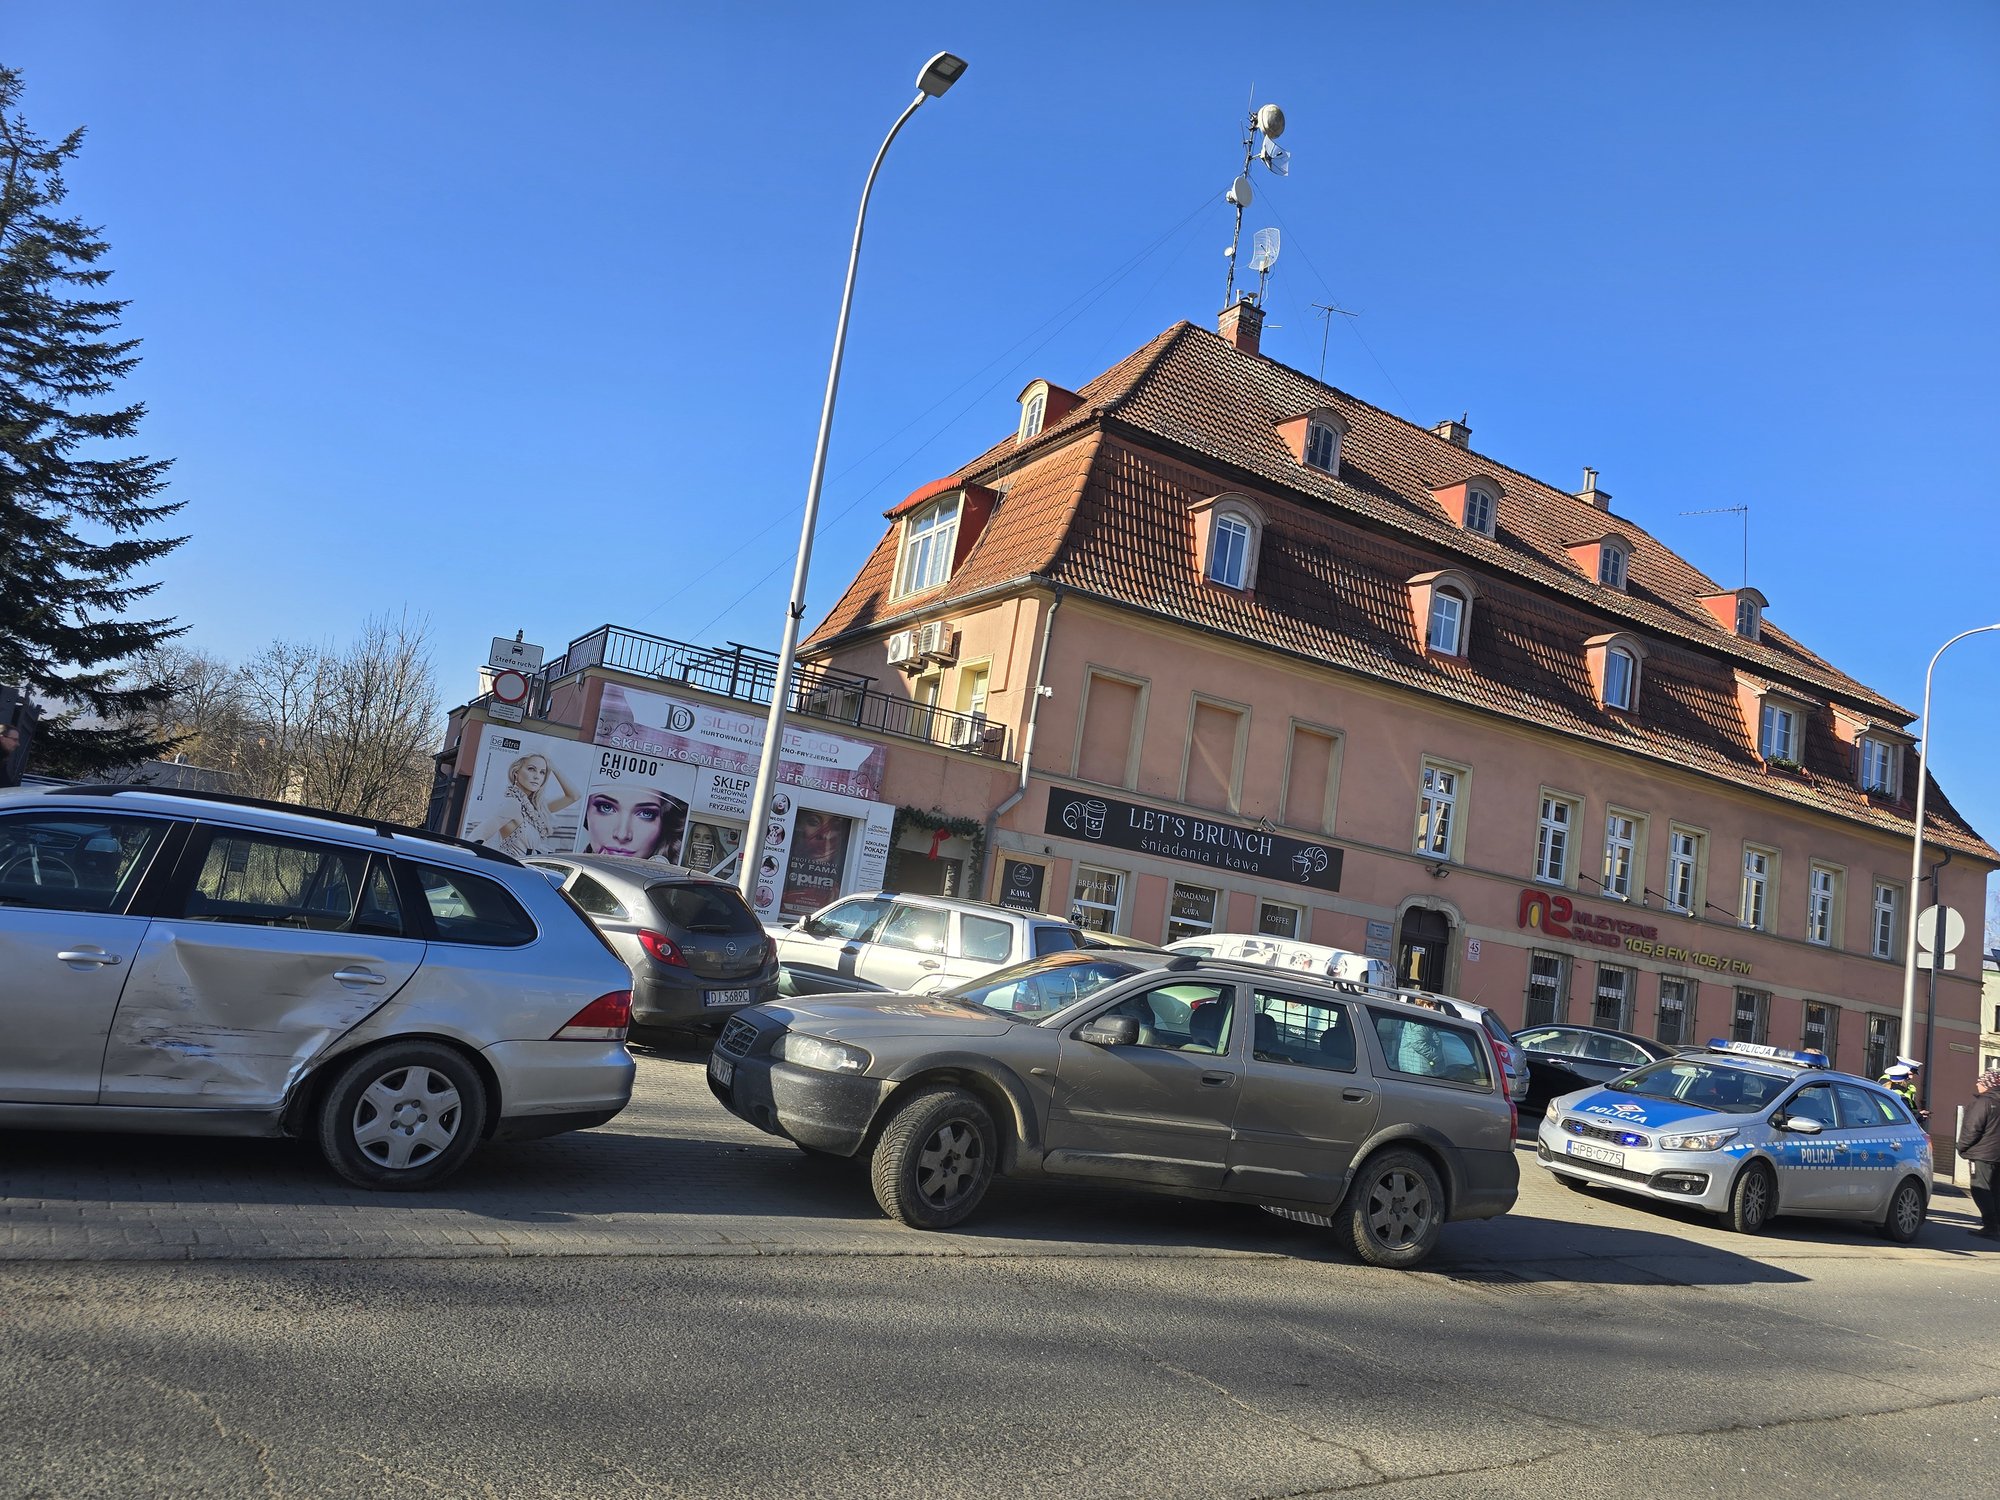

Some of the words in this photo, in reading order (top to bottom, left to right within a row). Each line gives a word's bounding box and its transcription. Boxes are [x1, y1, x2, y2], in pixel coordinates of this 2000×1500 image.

[495, 655, 516, 665] Strefa
[517, 661, 537, 669] ruchu
[700, 729, 743, 743] HURTOWNIA
[703, 715, 802, 747] SILHOUTE
[808, 740, 839, 755] DCD
[601, 752, 658, 777] CHIODO
[610, 736, 663, 755] SKLEP
[667, 747, 869, 798] KOSMETYCZ-FRYZJERSKI
[599, 767, 621, 779] PRO
[713, 775, 750, 791] SKLEP
[710, 794, 747, 805] KOSMETYCZNO
[711, 787, 748, 799] HURTOWNIA
[709, 803, 745, 815] FRYZJERSKA
[1129, 808, 1186, 837] LET'S
[1193, 821, 1273, 856] BRUNCH
[864, 846, 887, 855] POKAZY
[1140, 836, 1210, 862] śniadania
[1216, 852, 1220, 864] i
[1225, 853, 1259, 872] kawa
[791, 857, 838, 868] PROFESSIONAL
[791, 861, 804, 869] BY
[808, 864, 837, 875] FAMA
[1078, 879, 1115, 893] BREAKFAST
[1010, 889, 1030, 898] KAWA
[1174, 889, 1210, 903] ŚNIADANIA
[1181, 907, 1200, 917] KAWA
[1266, 915, 1290, 925] COFFEE
[1572, 908, 1658, 940] MUZYCZNE
[1571, 927, 1621, 948] RADIO
[1470, 942, 1479, 953] 45
[1625, 938, 1665, 958] 105,8
[1667, 947, 1690, 962] FM
[1692, 951, 1730, 971] 106,7
[1732, 959, 1753, 975] FM
[711, 991, 721, 1003] DJ
[724, 990, 748, 1002] 5689C
[1734, 1043, 1772, 1056] POLICJA
[1586, 1105, 1648, 1123] POLICJA
[1572, 1143, 1592, 1158] HPB
[1596, 1149, 1622, 1165] C775
[1801, 1148, 1836, 1164] POLICJA
